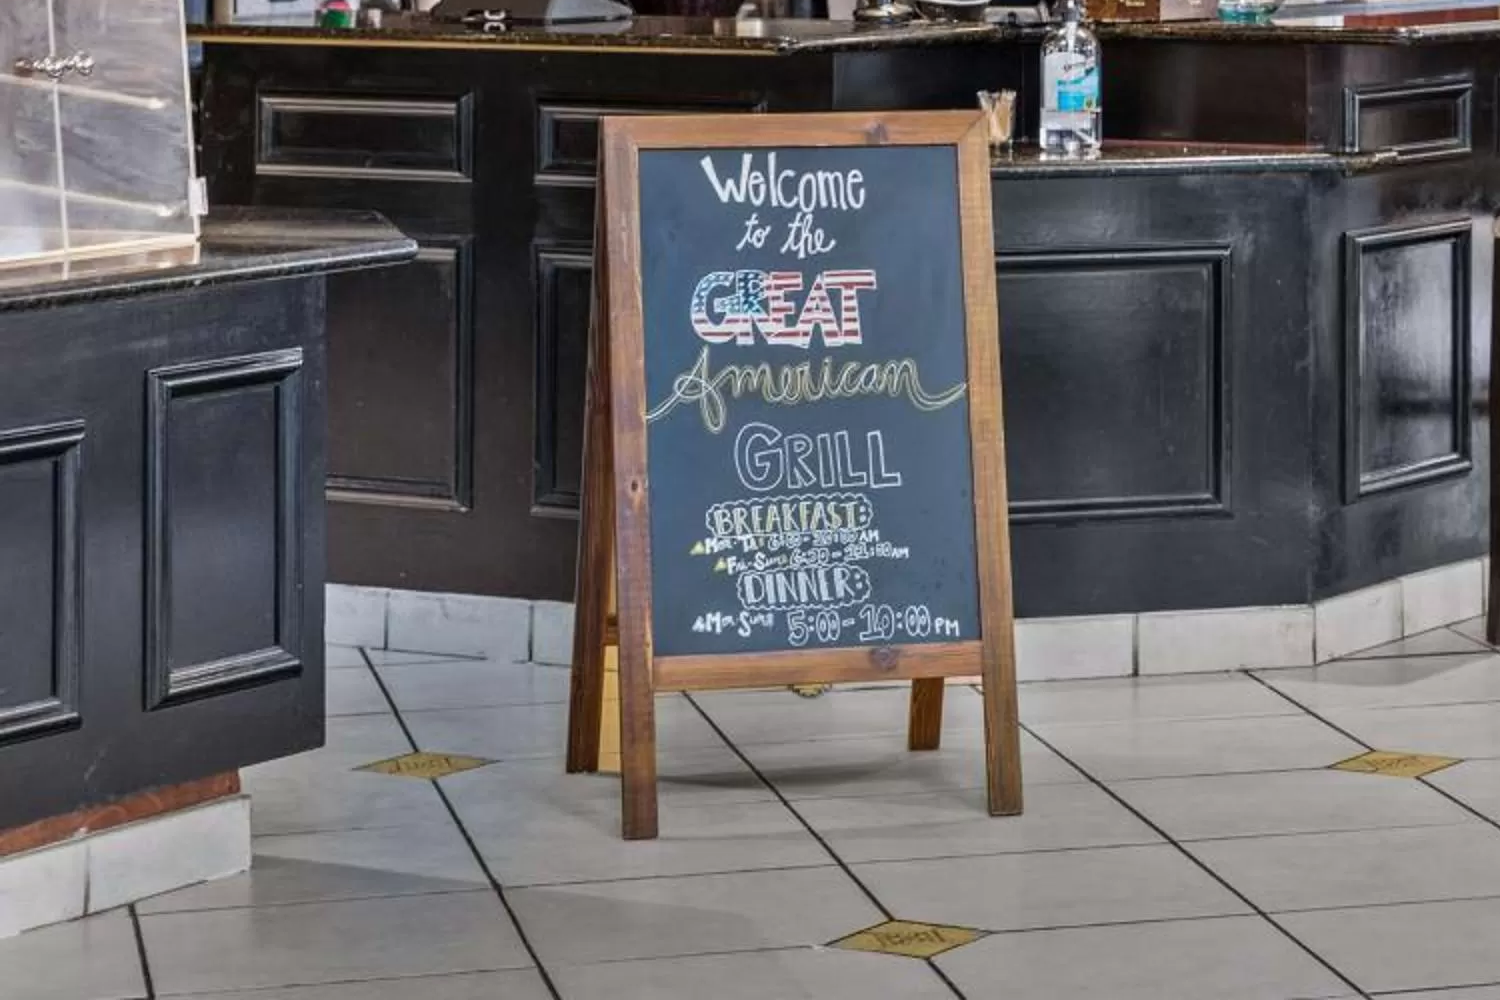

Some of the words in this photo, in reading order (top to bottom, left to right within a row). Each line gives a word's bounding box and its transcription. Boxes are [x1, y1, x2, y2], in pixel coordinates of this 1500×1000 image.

[700, 151, 865, 211] Welcome
[735, 213, 771, 252] to
[780, 211, 837, 258] the
[690, 269, 877, 348] GREAT
[643, 345, 968, 435] American
[733, 421, 901, 492] GRILL
[934, 616, 961, 637] PM
